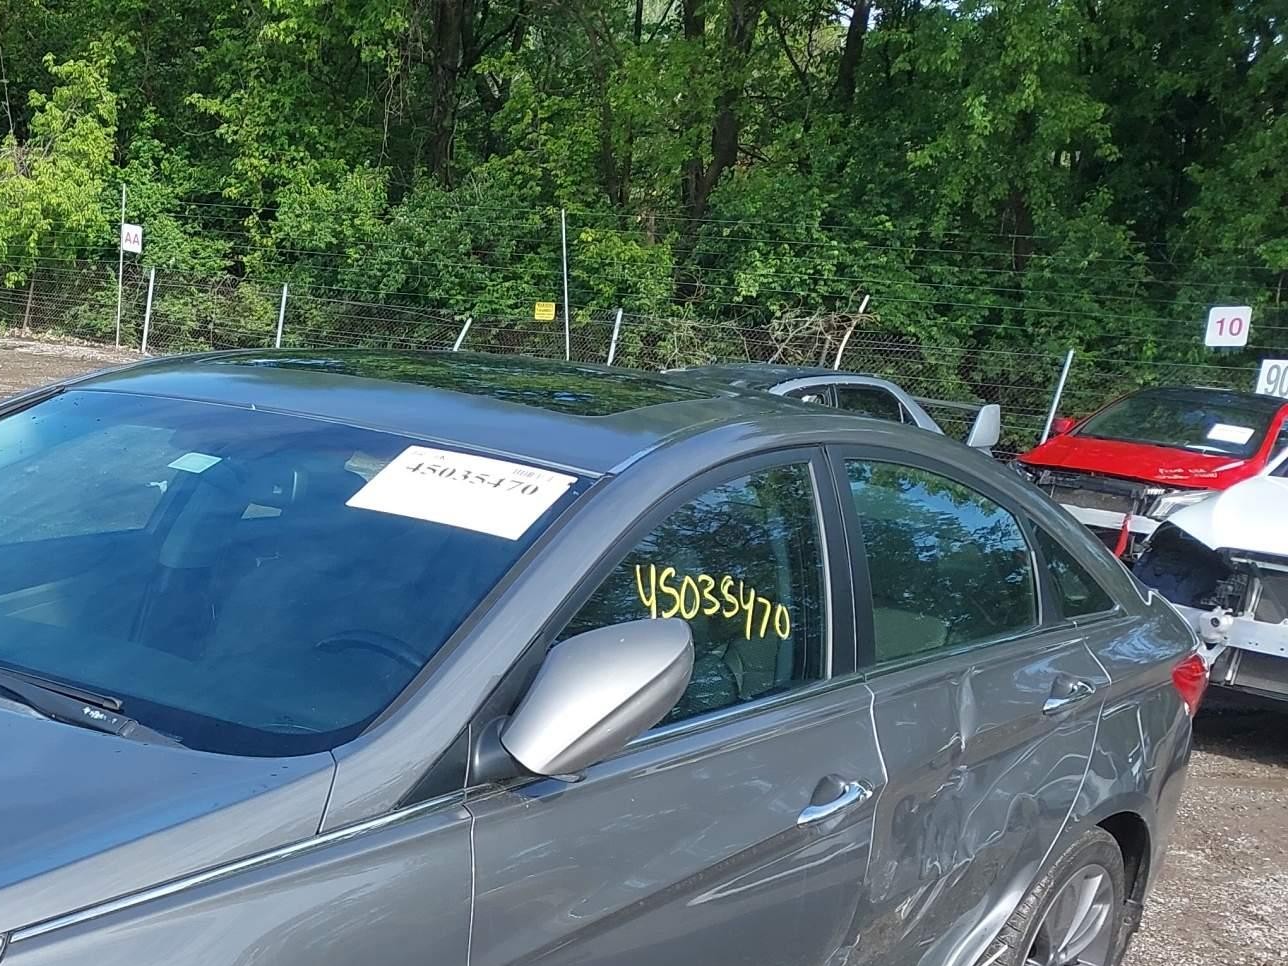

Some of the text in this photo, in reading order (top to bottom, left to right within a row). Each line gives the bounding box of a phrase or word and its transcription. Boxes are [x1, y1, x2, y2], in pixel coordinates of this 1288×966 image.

[124, 231, 140, 246] AA
[1215, 317, 1244, 337] 10
[405, 461, 540, 496] 45035470
[635, 563, 791, 641] 45035470
